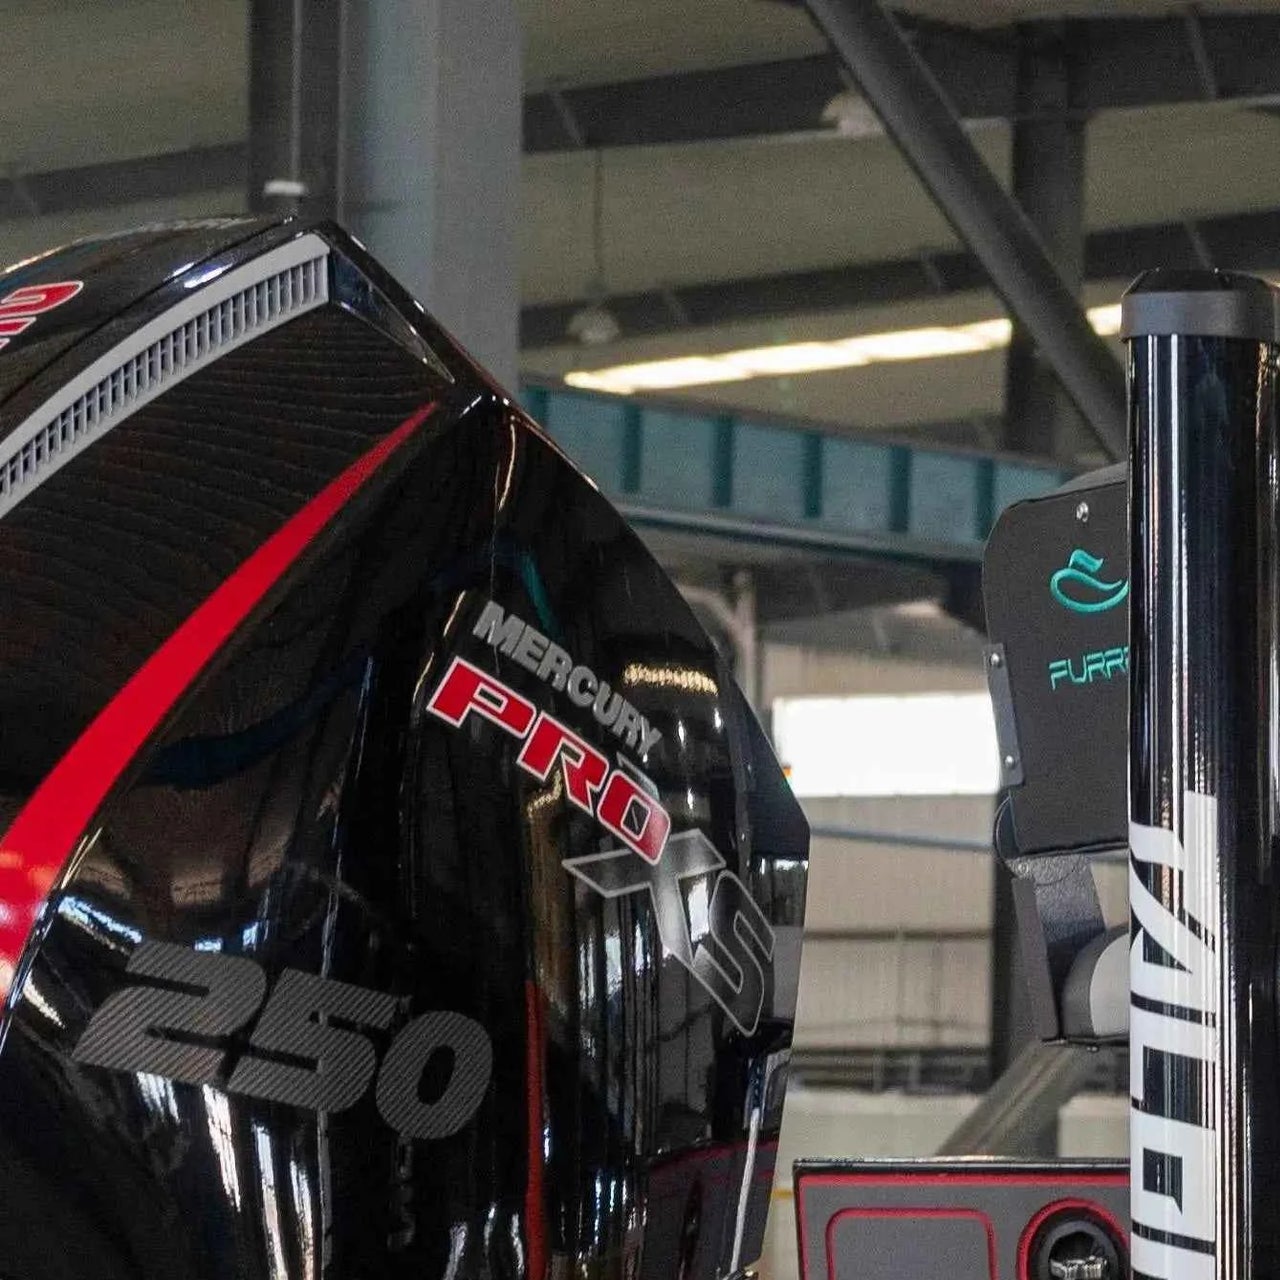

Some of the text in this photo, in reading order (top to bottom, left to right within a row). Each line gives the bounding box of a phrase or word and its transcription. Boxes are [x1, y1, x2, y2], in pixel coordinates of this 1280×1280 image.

[472, 600, 663, 756] MERCURY
[1048, 646, 1129, 691] FURR
[426, 655, 672, 866] PRO
[70, 940, 494, 1140] 250
